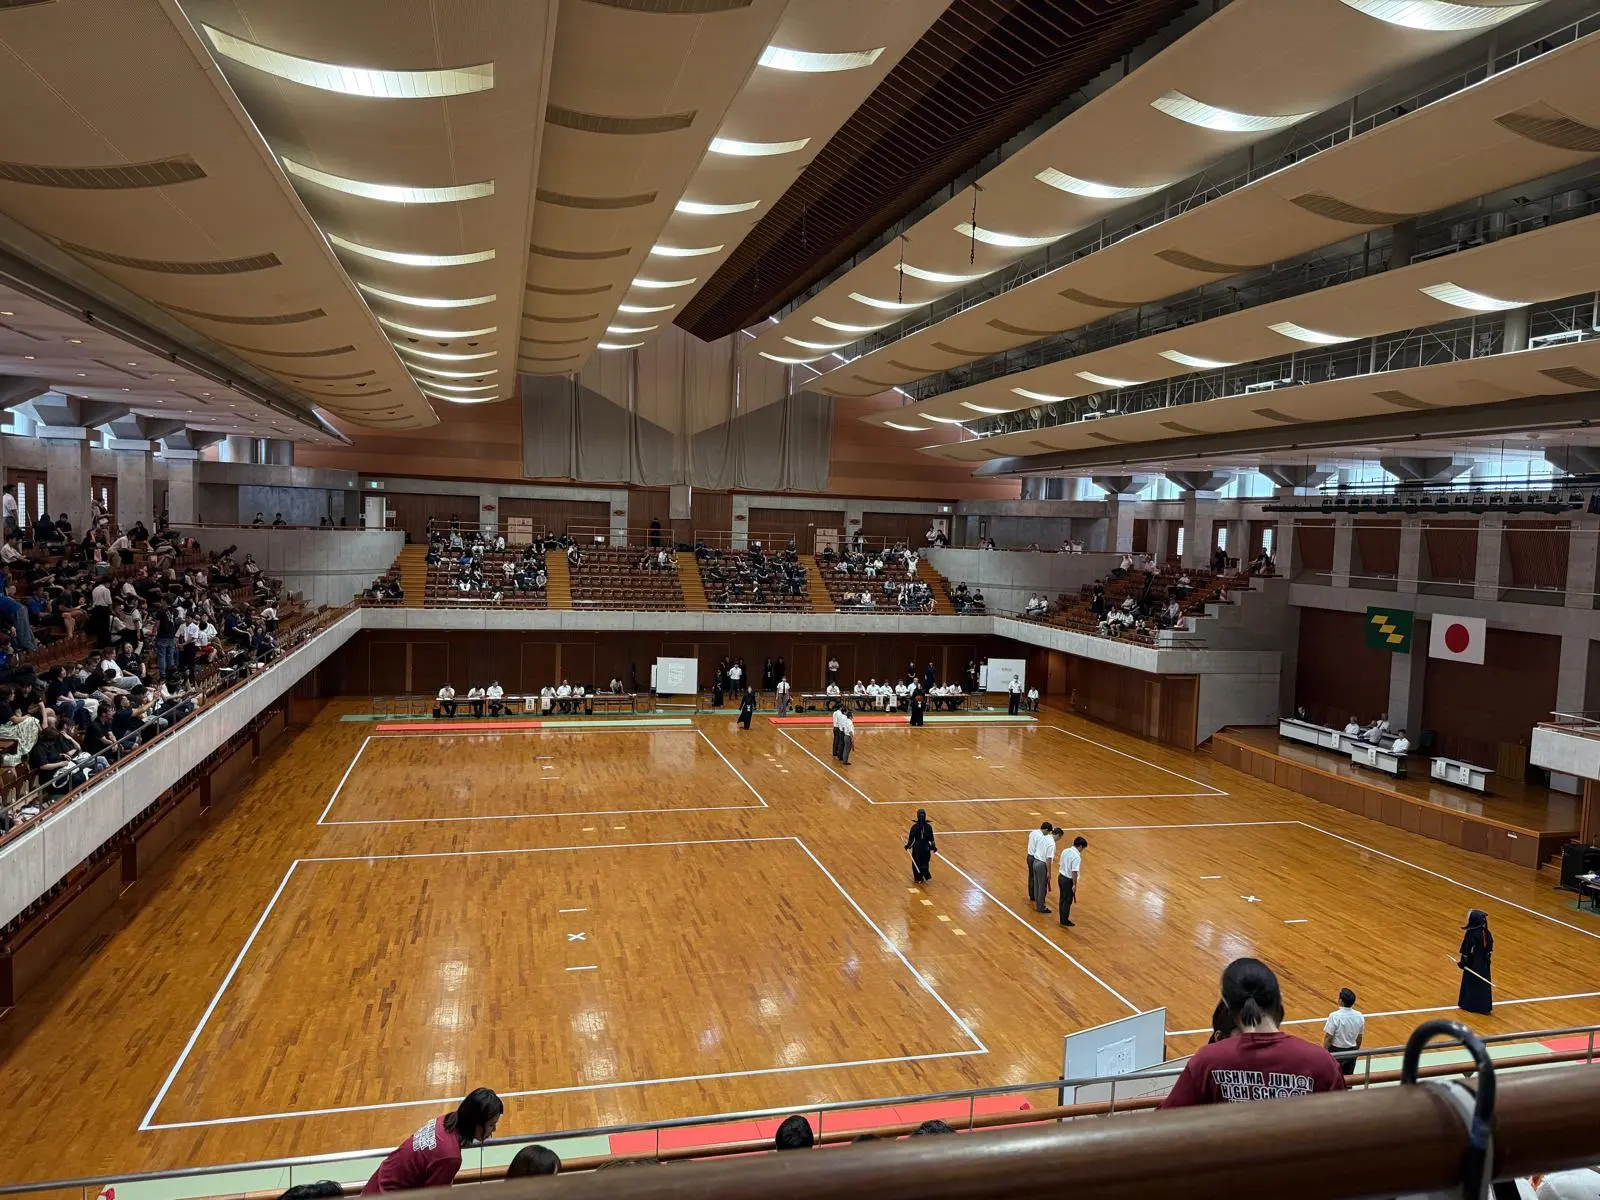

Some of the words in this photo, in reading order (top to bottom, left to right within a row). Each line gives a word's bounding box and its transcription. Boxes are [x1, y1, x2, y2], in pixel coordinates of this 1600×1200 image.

[1211, 1070, 1265, 1086] YUSHIMA
[1269, 1072, 1314, 1091] JUNIOR
[1220, 1084, 1249, 1100] HIGH
